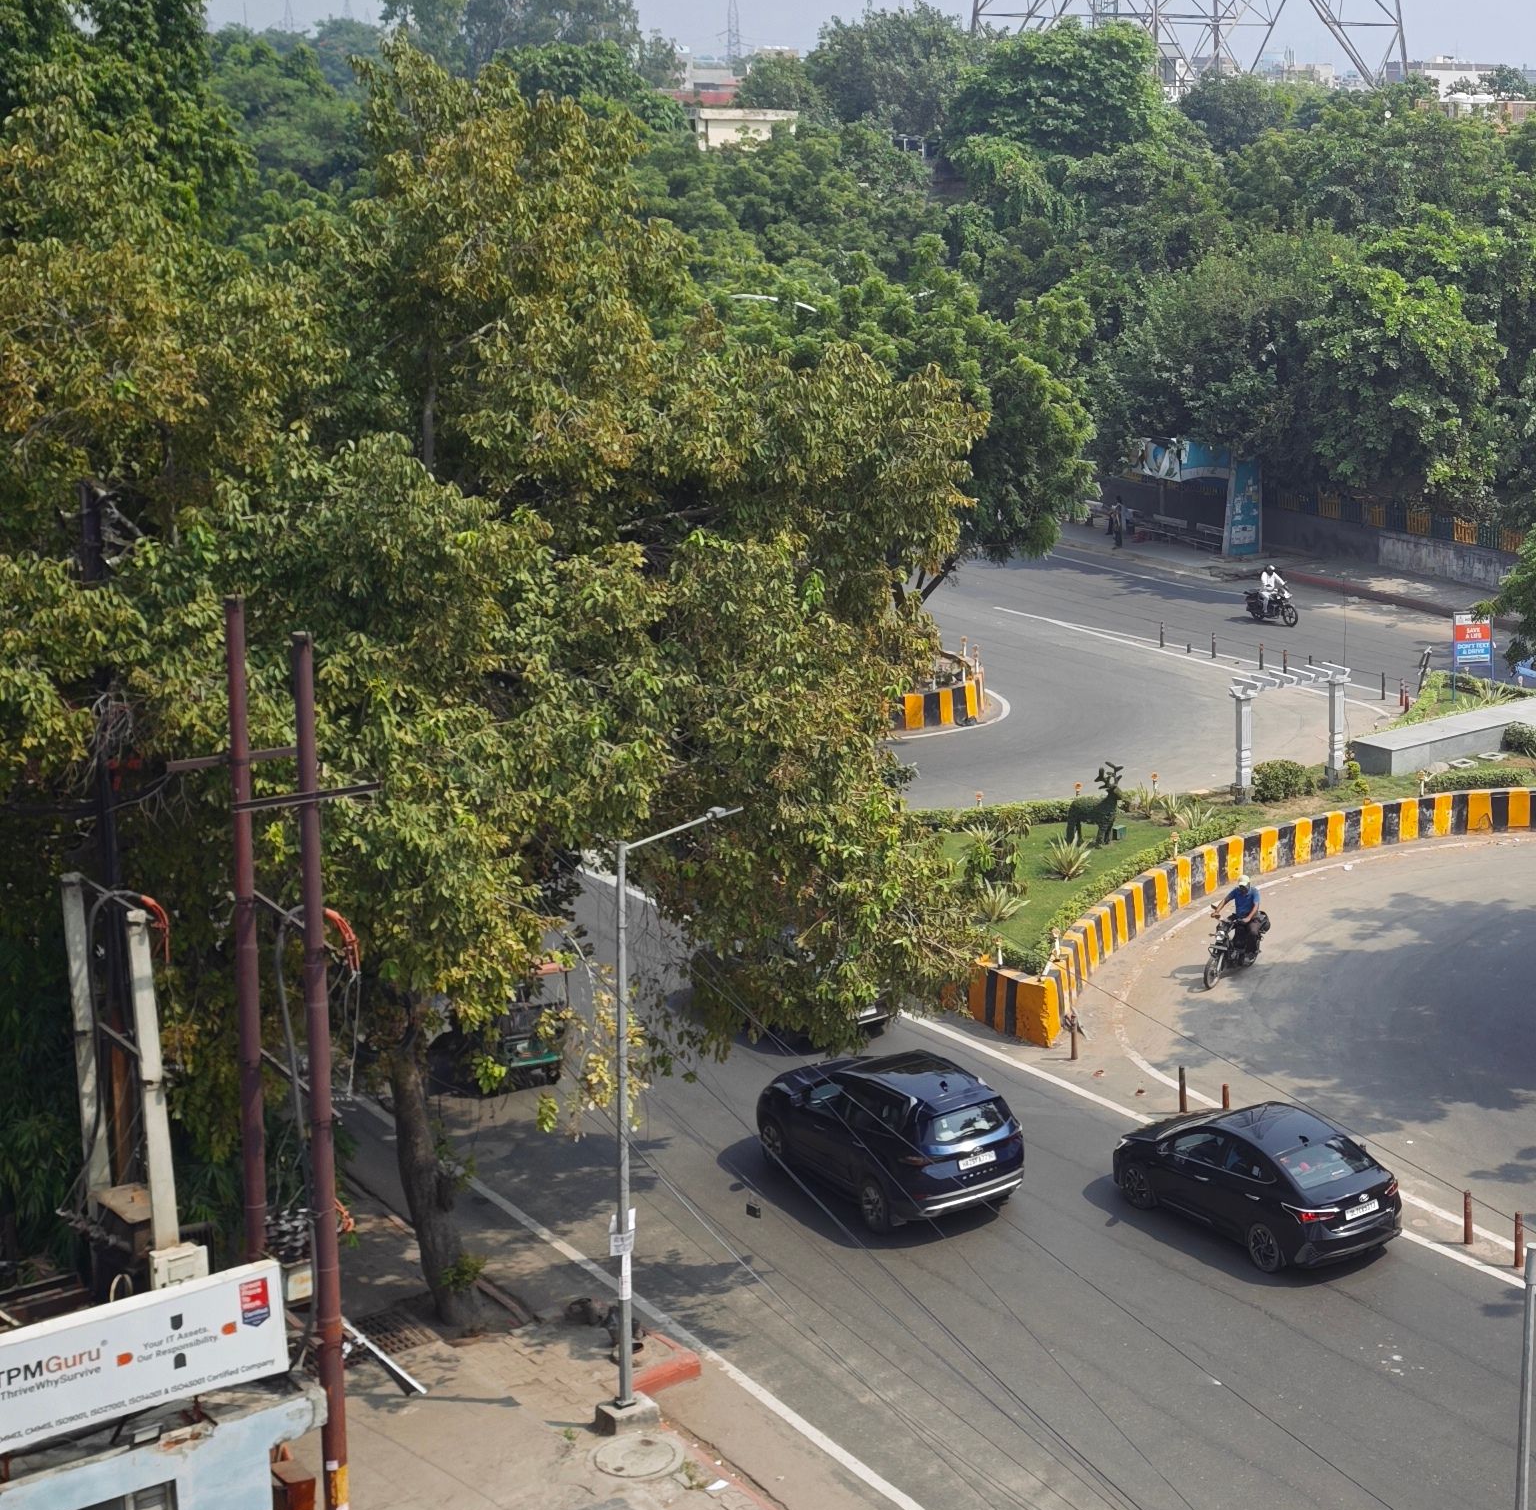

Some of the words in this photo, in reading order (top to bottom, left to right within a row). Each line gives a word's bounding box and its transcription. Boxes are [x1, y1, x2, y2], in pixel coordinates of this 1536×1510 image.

[143, 1338, 164, 1351] Your
[166, 1334, 175, 1344] IT
[137, 1351, 153, 1363] Our
[207, 1367, 239, 1383] Certified
[241, 1358, 275, 1373] Company
